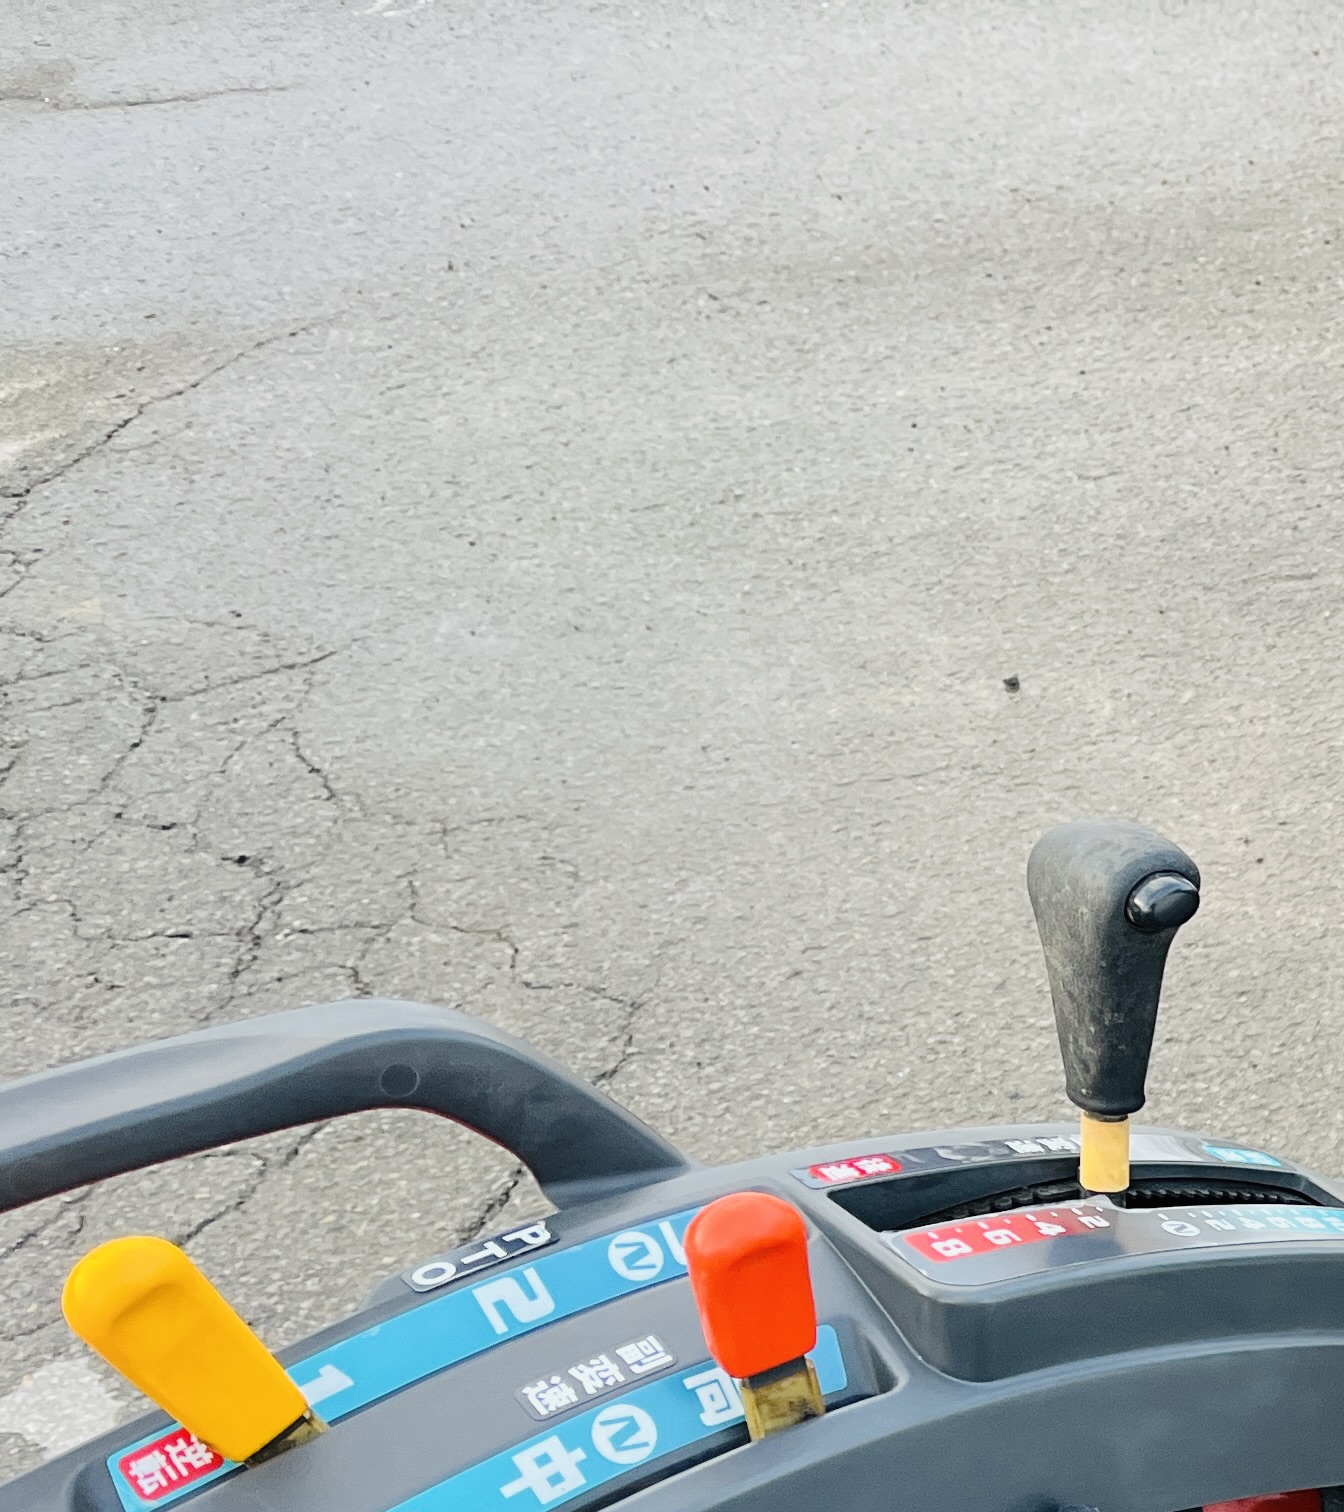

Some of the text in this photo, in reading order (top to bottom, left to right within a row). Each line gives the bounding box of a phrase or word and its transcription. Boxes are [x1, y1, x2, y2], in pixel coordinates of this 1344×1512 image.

[411, 1223, 552, 1292] PTO
[931, 1214, 1110, 1257] 2 4 6 8
[472, 1268, 556, 1335] 2
[523, 1335, 668, 1417] 副変速
[128, 1434, 214, 1497] 逆転
[499, 1446, 588, 1504] 中
